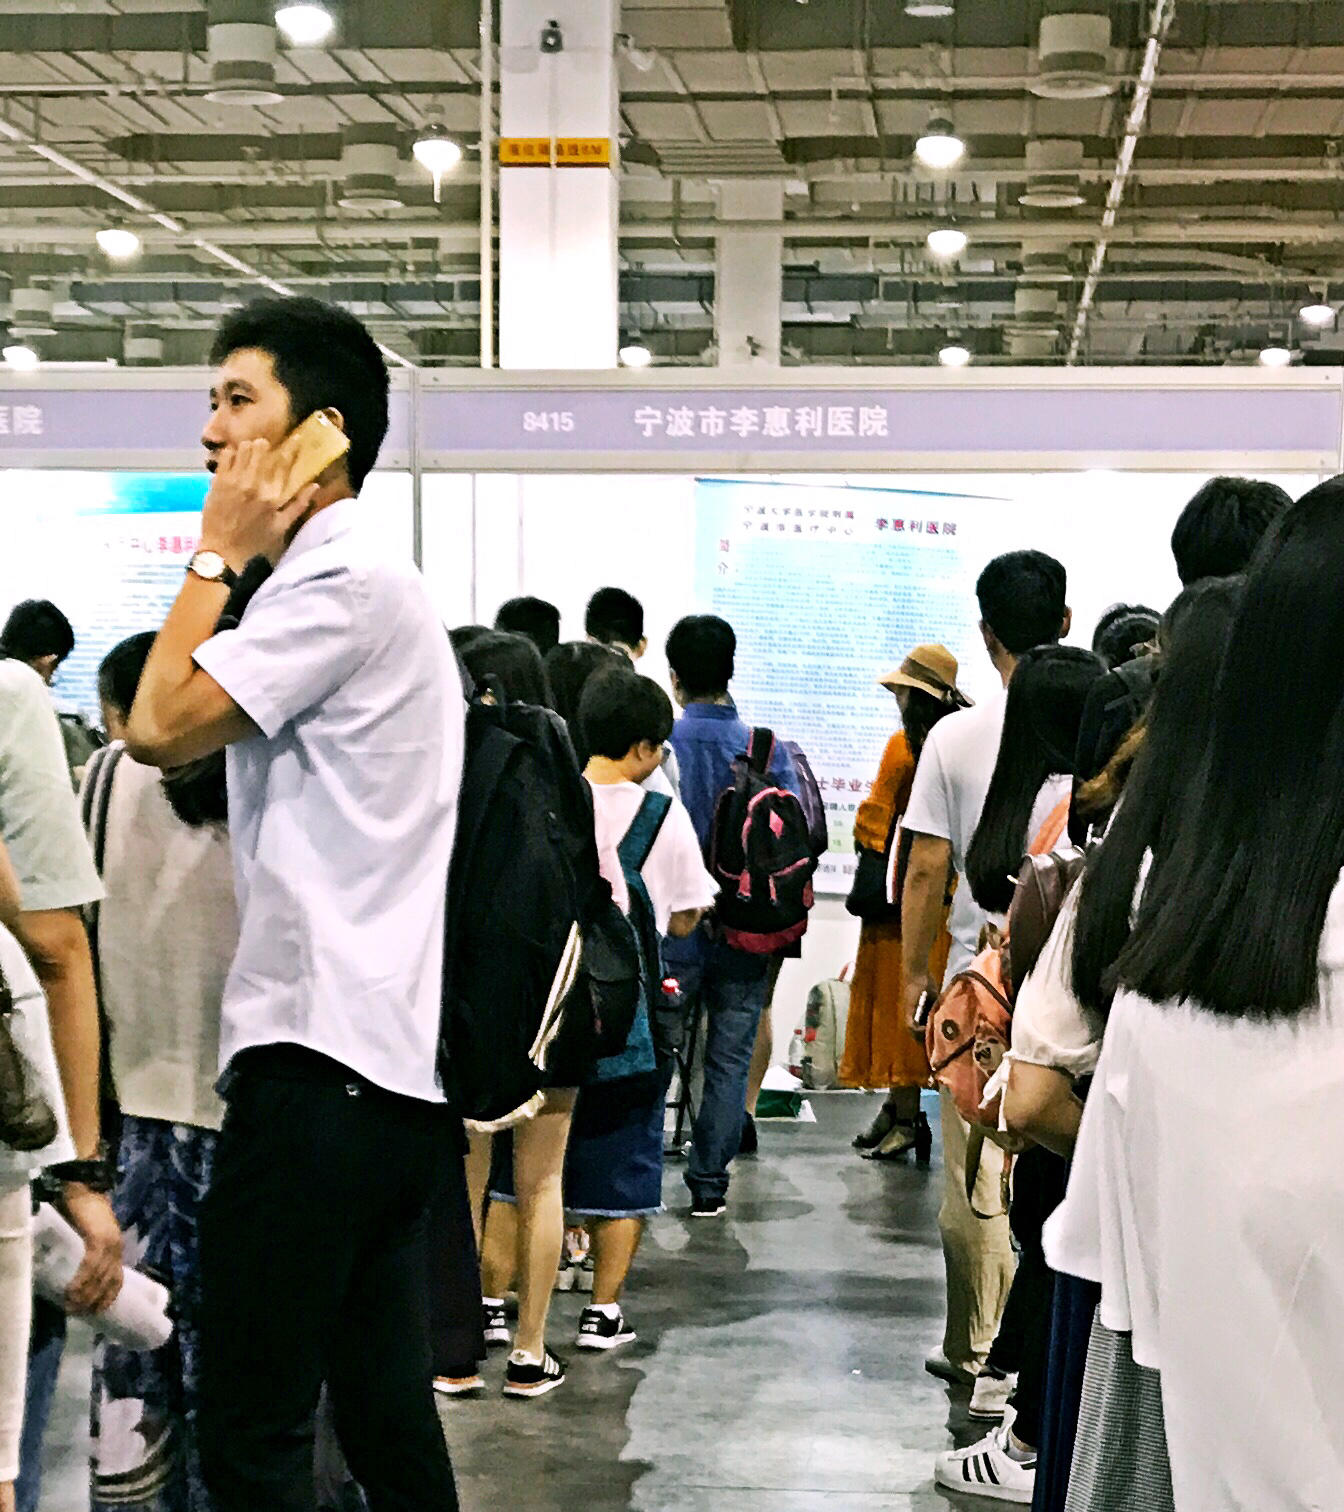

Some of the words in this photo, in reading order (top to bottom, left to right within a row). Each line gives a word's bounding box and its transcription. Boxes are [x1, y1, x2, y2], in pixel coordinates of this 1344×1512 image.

[522, 411, 575, 432] 8415
[633, 405, 889, 437] 宁波市李惠利医院
